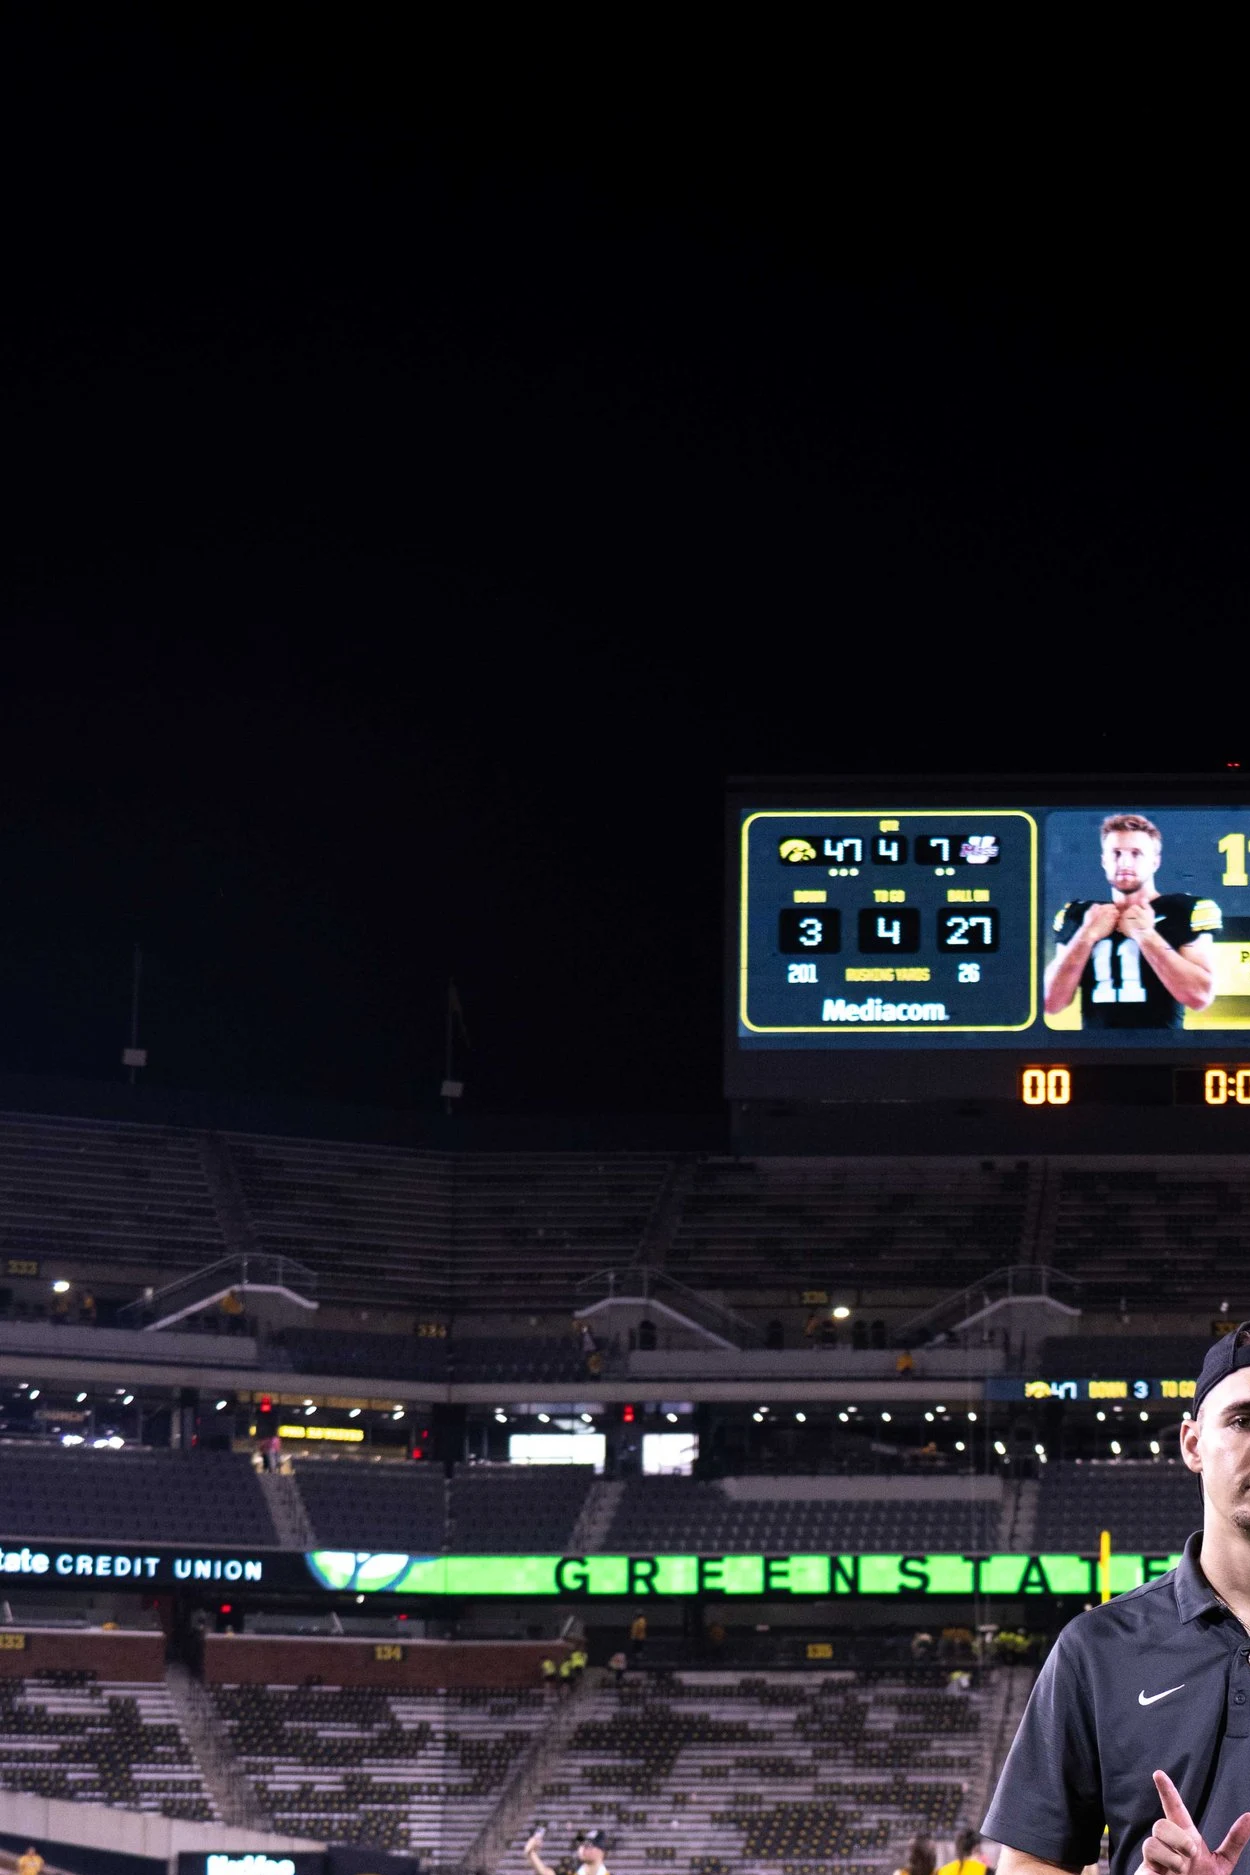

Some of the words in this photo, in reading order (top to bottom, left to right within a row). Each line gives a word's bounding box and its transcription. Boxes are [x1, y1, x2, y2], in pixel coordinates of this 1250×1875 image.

[823, 837, 863, 862] 47
[878, 838, 899, 862] 4
[929, 837, 950, 862] 7
[799, 917, 823, 947] 3
[877, 916, 901, 945] 4
[945, 915, 993, 945] 27
[787, 963, 819, 984] 201
[957, 962, 981, 984] 26
[1091, 938, 1148, 1004] 11
[822, 996, 950, 1022] Mediacom
[1022, 1068, 1071, 1105] 00
[1049, 1381, 1078, 1400] 47
[1132, 1380, 1148, 1399] 3
[55, 1554, 160, 1576] CREDIT
[174, 1559, 262, 1581] UNION
